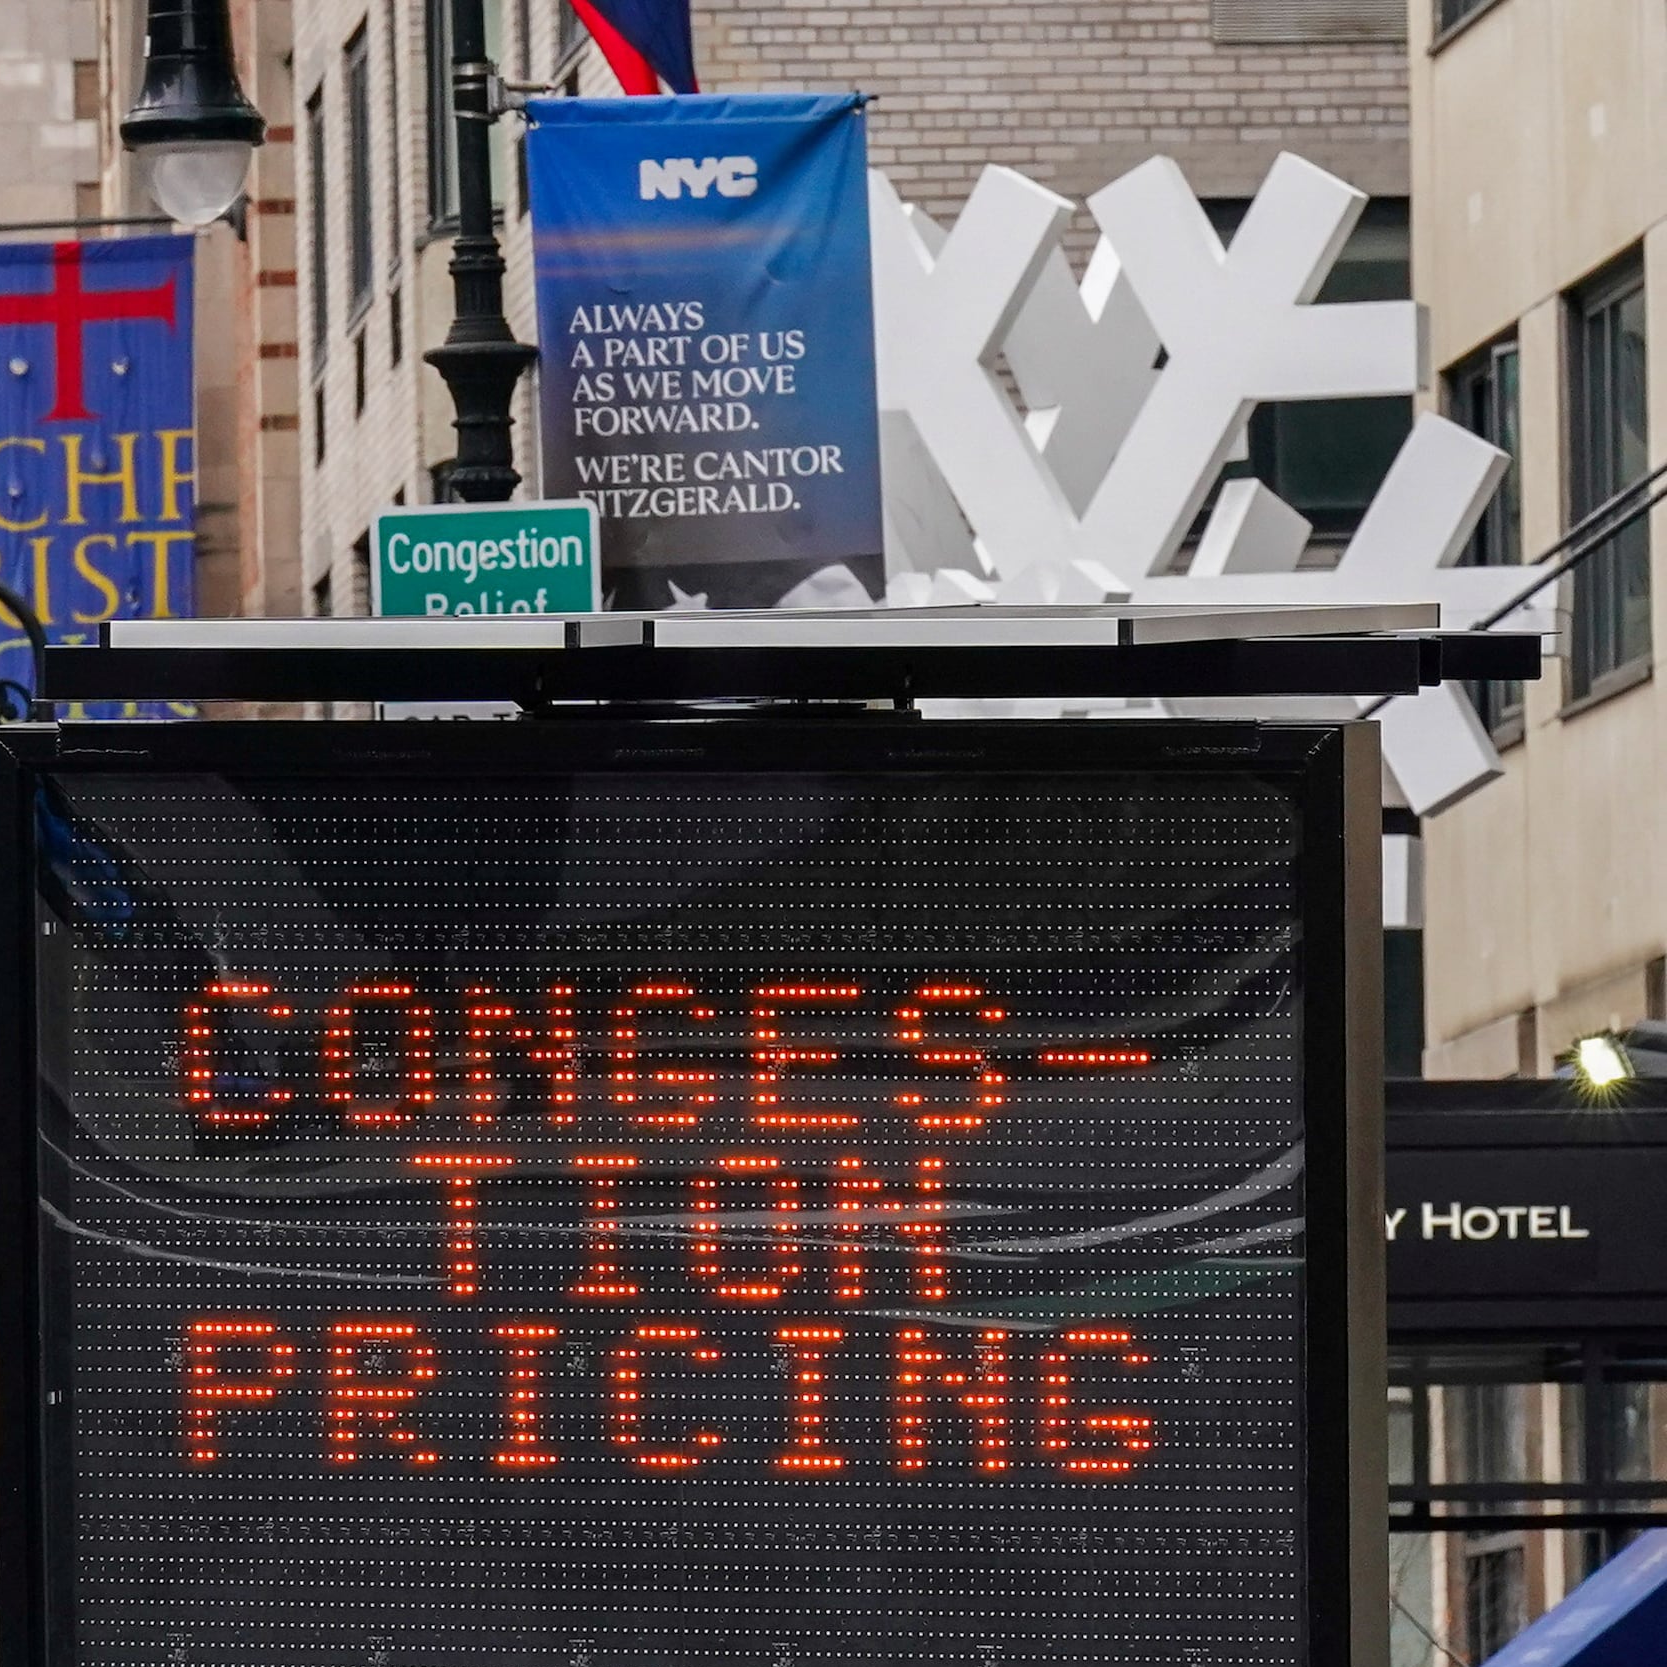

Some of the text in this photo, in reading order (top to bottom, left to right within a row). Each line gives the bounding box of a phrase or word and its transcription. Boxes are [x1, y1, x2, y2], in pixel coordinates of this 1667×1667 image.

[640, 157, 758, 200] NYC
[569, 302, 705, 333] ALWAYS
[571, 330, 805, 368] A PART OF US
[572, 365, 795, 402] AS WE MOVE
[575, 402, 760, 437] FORWARD.
[575, 445, 844, 484] WE'RE CANTOR
[388, 527, 583, 584] Congestion
[412, 1154, 944, 1298] TION
[189, 1322, 1153, 1470] PRICING
